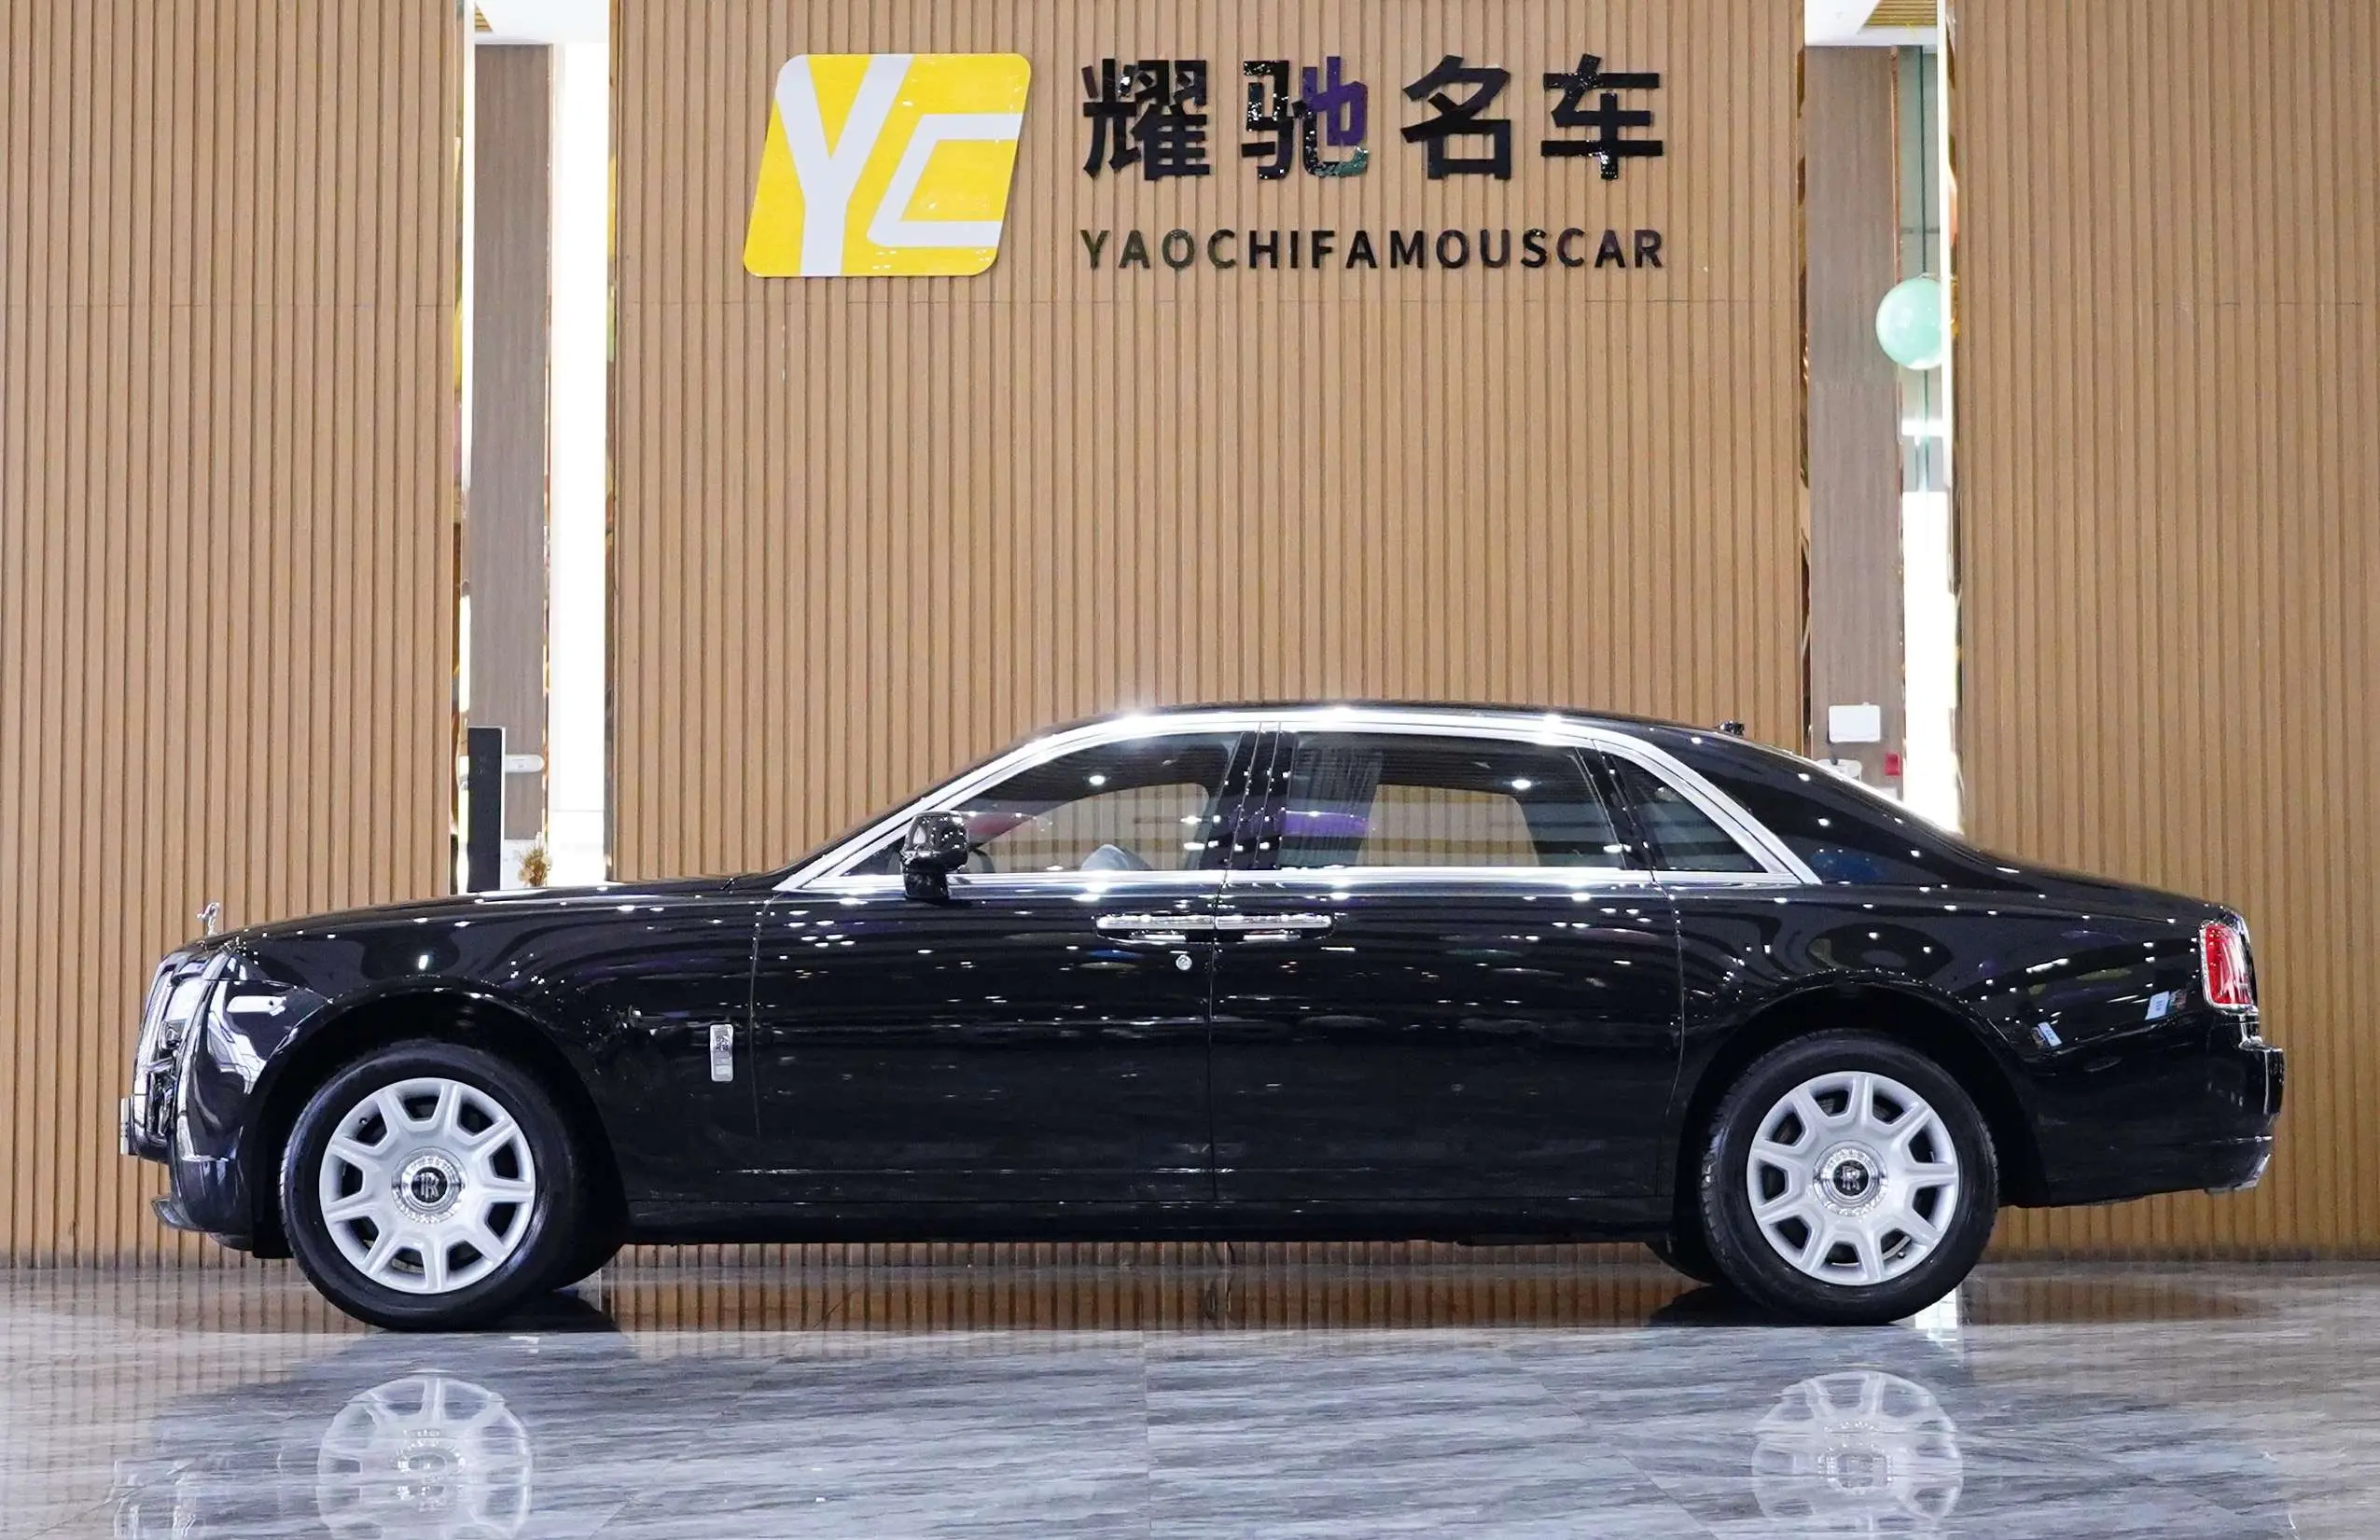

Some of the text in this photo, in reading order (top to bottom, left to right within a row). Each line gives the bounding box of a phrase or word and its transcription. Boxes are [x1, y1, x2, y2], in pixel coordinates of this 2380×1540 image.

[1081, 54, 1663, 181] 耀驰名车
[1079, 229, 1663, 270] YAOCHIFAMOUSCAR
